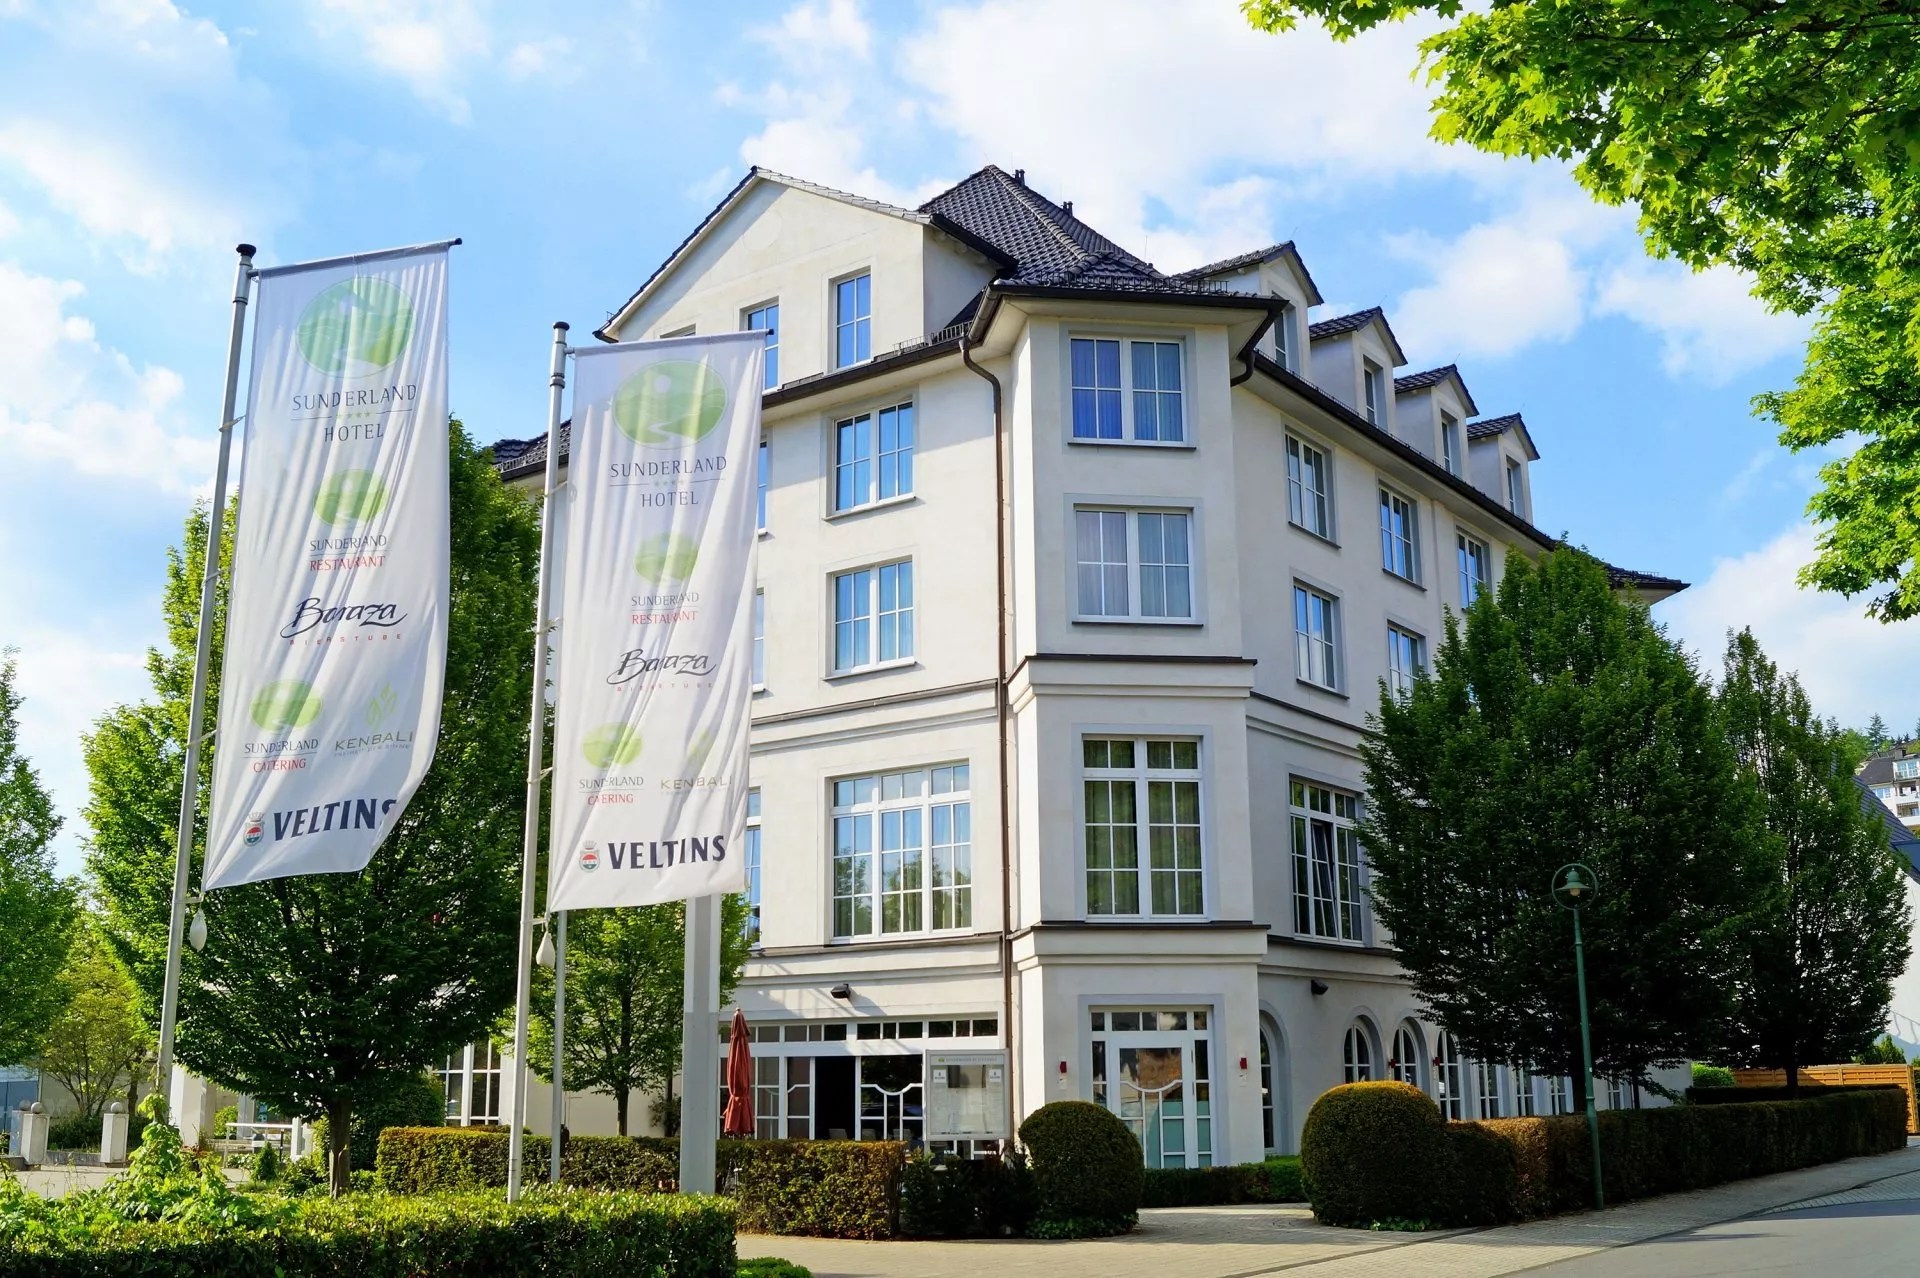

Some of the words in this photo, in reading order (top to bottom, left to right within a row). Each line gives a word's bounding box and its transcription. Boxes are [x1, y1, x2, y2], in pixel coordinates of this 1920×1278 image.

[292, 384, 417, 411] SUNDERLAND
[324, 423, 384, 442] HOTEL
[607, 456, 728, 478] SUNDERLAND
[641, 491, 699, 508] HOTEL
[244, 738, 319, 754] SUNDERLAND
[335, 731, 413, 751] KENBALI
[253, 758, 307, 773] CATERING
[660, 776, 732, 790] KENBALI
[587, 793, 634, 806] CAERING
[608, 835, 726, 870] VELTINS
